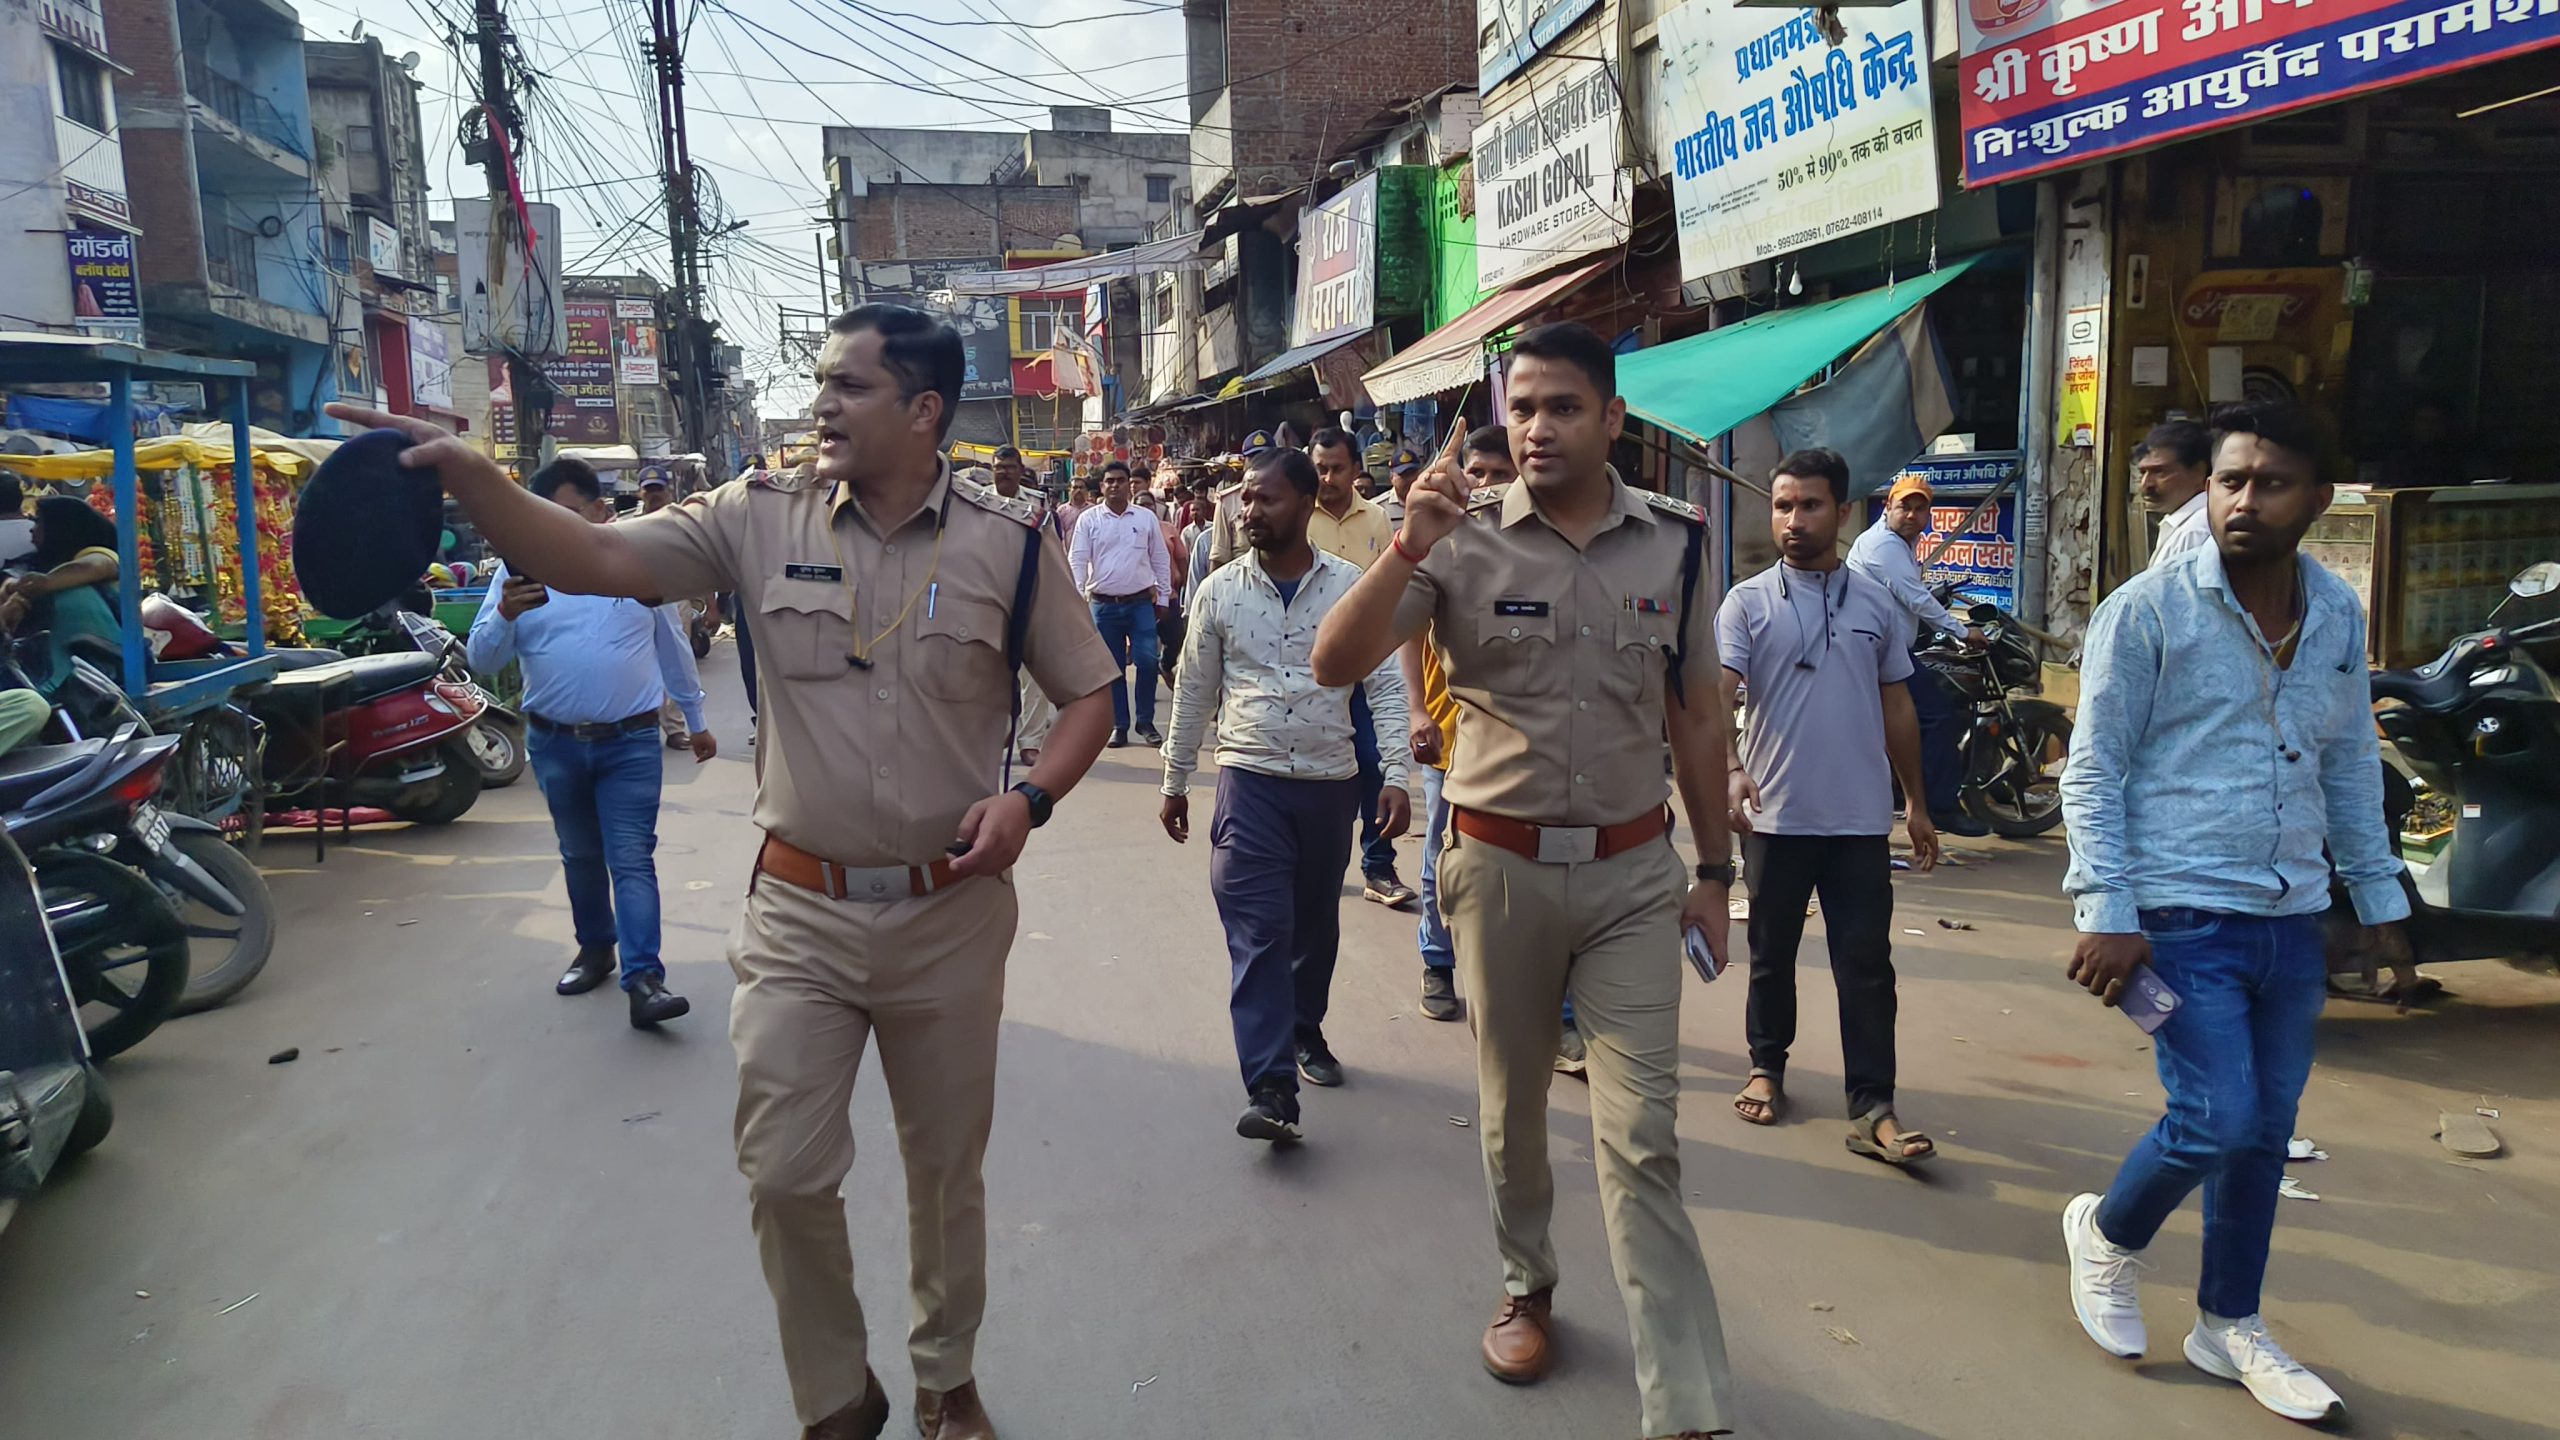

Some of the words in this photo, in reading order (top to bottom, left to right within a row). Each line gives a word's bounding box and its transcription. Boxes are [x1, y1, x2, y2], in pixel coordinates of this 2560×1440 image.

[1972, 48, 2031, 104] श्री
[2038, 8, 2164, 96] कृष्ण
[2142, 42, 2325, 119] आयुर्वेद
[1674, 111, 1738, 181] भारतीय
[1740, 96, 1778, 152] जन
[1781, 48, 1857, 137] औषधि
[1860, 30, 1918, 100] केन्द्र
[1477, 123, 1502, 184] काशी
[1504, 112, 1538, 168] गोपाल
[1777, 166, 1804, 191] 50%
[1805, 155, 1816, 180] से
[1818, 149, 1848, 177] 90%
[1849, 142, 1871, 165] तक
[1872, 126, 1889, 155] की
[1892, 119, 1924, 146] बचत
[1497, 171, 1538, 229] KASHI
[1542, 144, 1594, 207] GOPAL
[69, 235, 129, 259] मॉडर्न
[1322, 196, 1351, 261] राज
[1499, 218, 1550, 250] HARDWARE
[1553, 200, 1595, 228] STORES
[1311, 269, 1357, 333] घराना
[1943, 469, 1961, 481] जन
